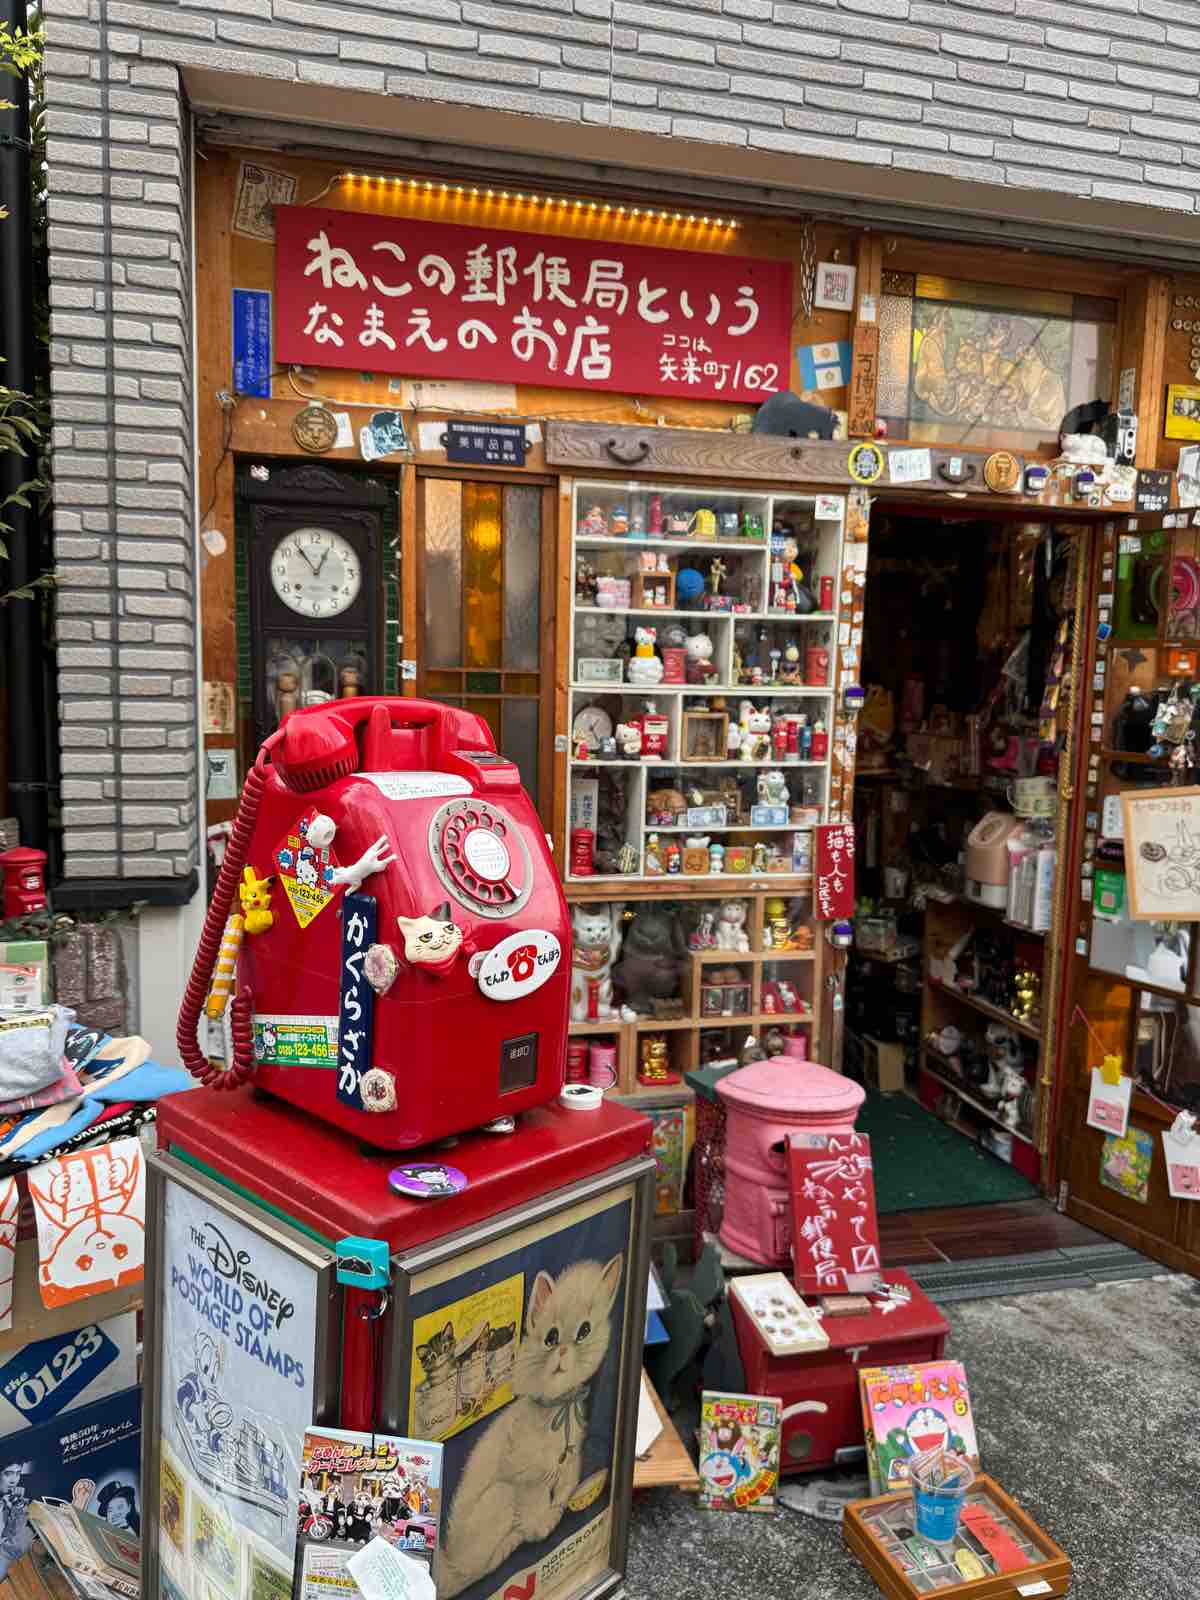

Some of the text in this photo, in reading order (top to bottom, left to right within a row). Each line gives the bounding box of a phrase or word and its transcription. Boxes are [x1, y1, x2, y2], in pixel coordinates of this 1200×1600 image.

[303, 230, 759, 336] ねこの郵便局という
[303, 301, 613, 381] なまえのお店
[663, 333, 712, 353] ココは
[338, 912, 369, 1095] かぐらざか
[189, 1225, 206, 1250] THE
[171, 1264, 305, 1388] POSTAGE STAMPS
[187, 1253, 275, 1337] WORLD OF
[15, 1325, 103, 1410] 0123
